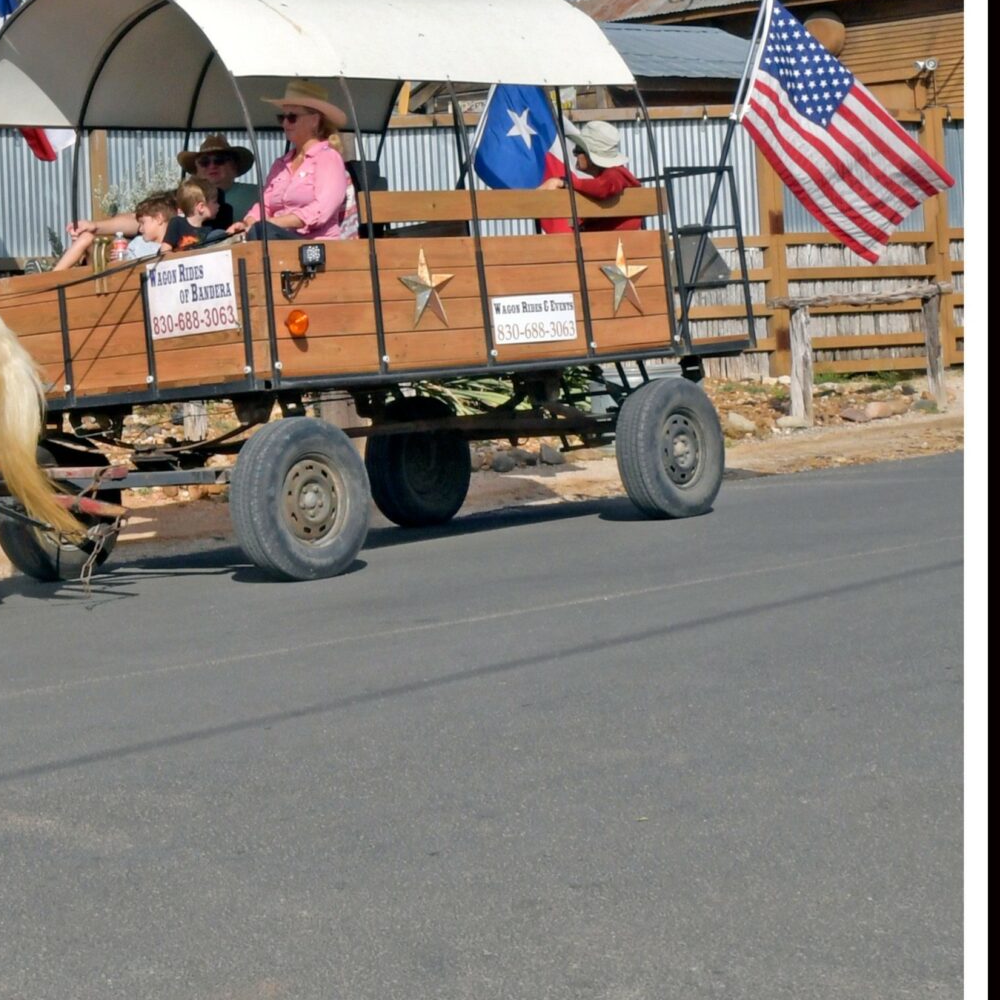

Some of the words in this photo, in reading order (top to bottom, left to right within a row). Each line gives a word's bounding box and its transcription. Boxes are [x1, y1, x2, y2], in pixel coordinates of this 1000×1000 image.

[148, 268, 177, 287] WAGON
[178, 264, 204, 282] RIDES
[179, 289, 190, 304] OF
[191, 283, 232, 302] BANDERA
[493, 302, 521, 315] WAGON
[521, 301, 543, 313] RIDES
[543, 300, 549, 312] &
[550, 300, 574, 312] EVENTS
[153, 305, 235, 334] 830-688-3063
[497, 320, 576, 341] 830-688-3063
